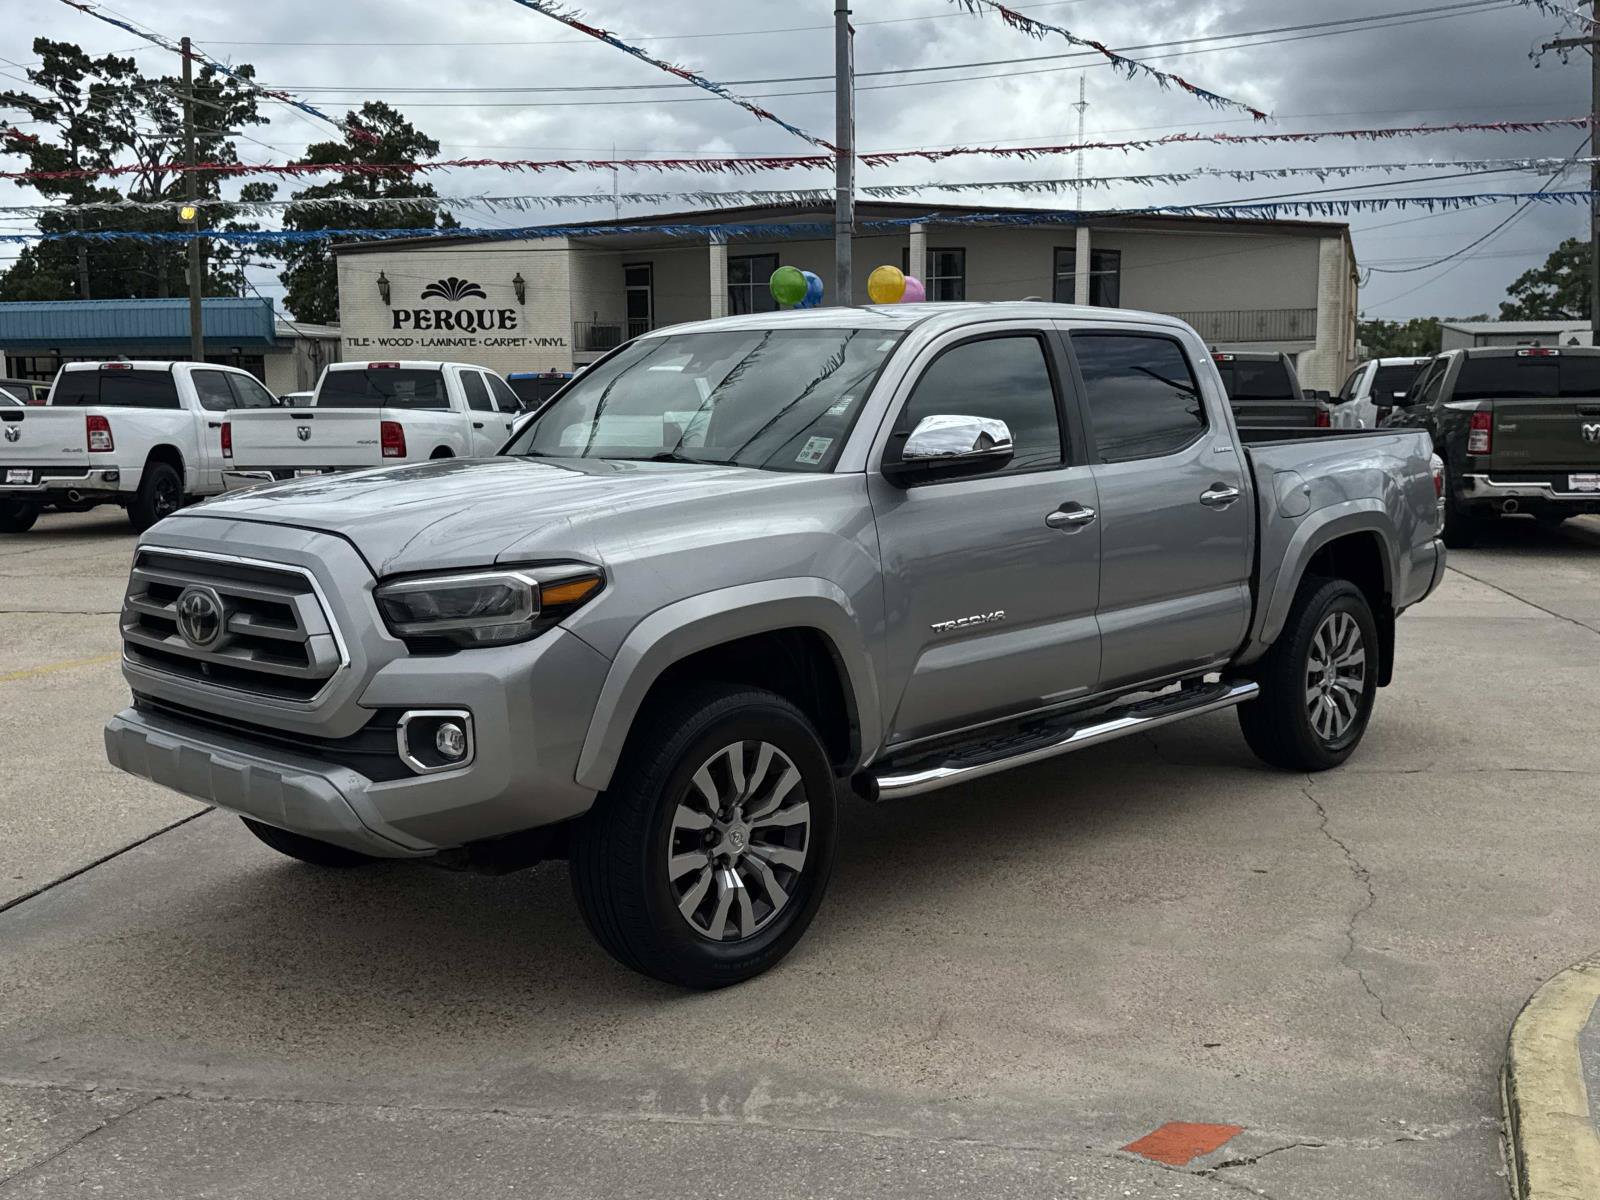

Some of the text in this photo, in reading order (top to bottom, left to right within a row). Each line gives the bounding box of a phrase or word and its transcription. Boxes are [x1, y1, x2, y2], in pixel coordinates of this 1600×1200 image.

[392, 309, 517, 333] PERQUE
[347, 338, 567, 346] TILE WOOD LAMINATE CARPET VINYL
